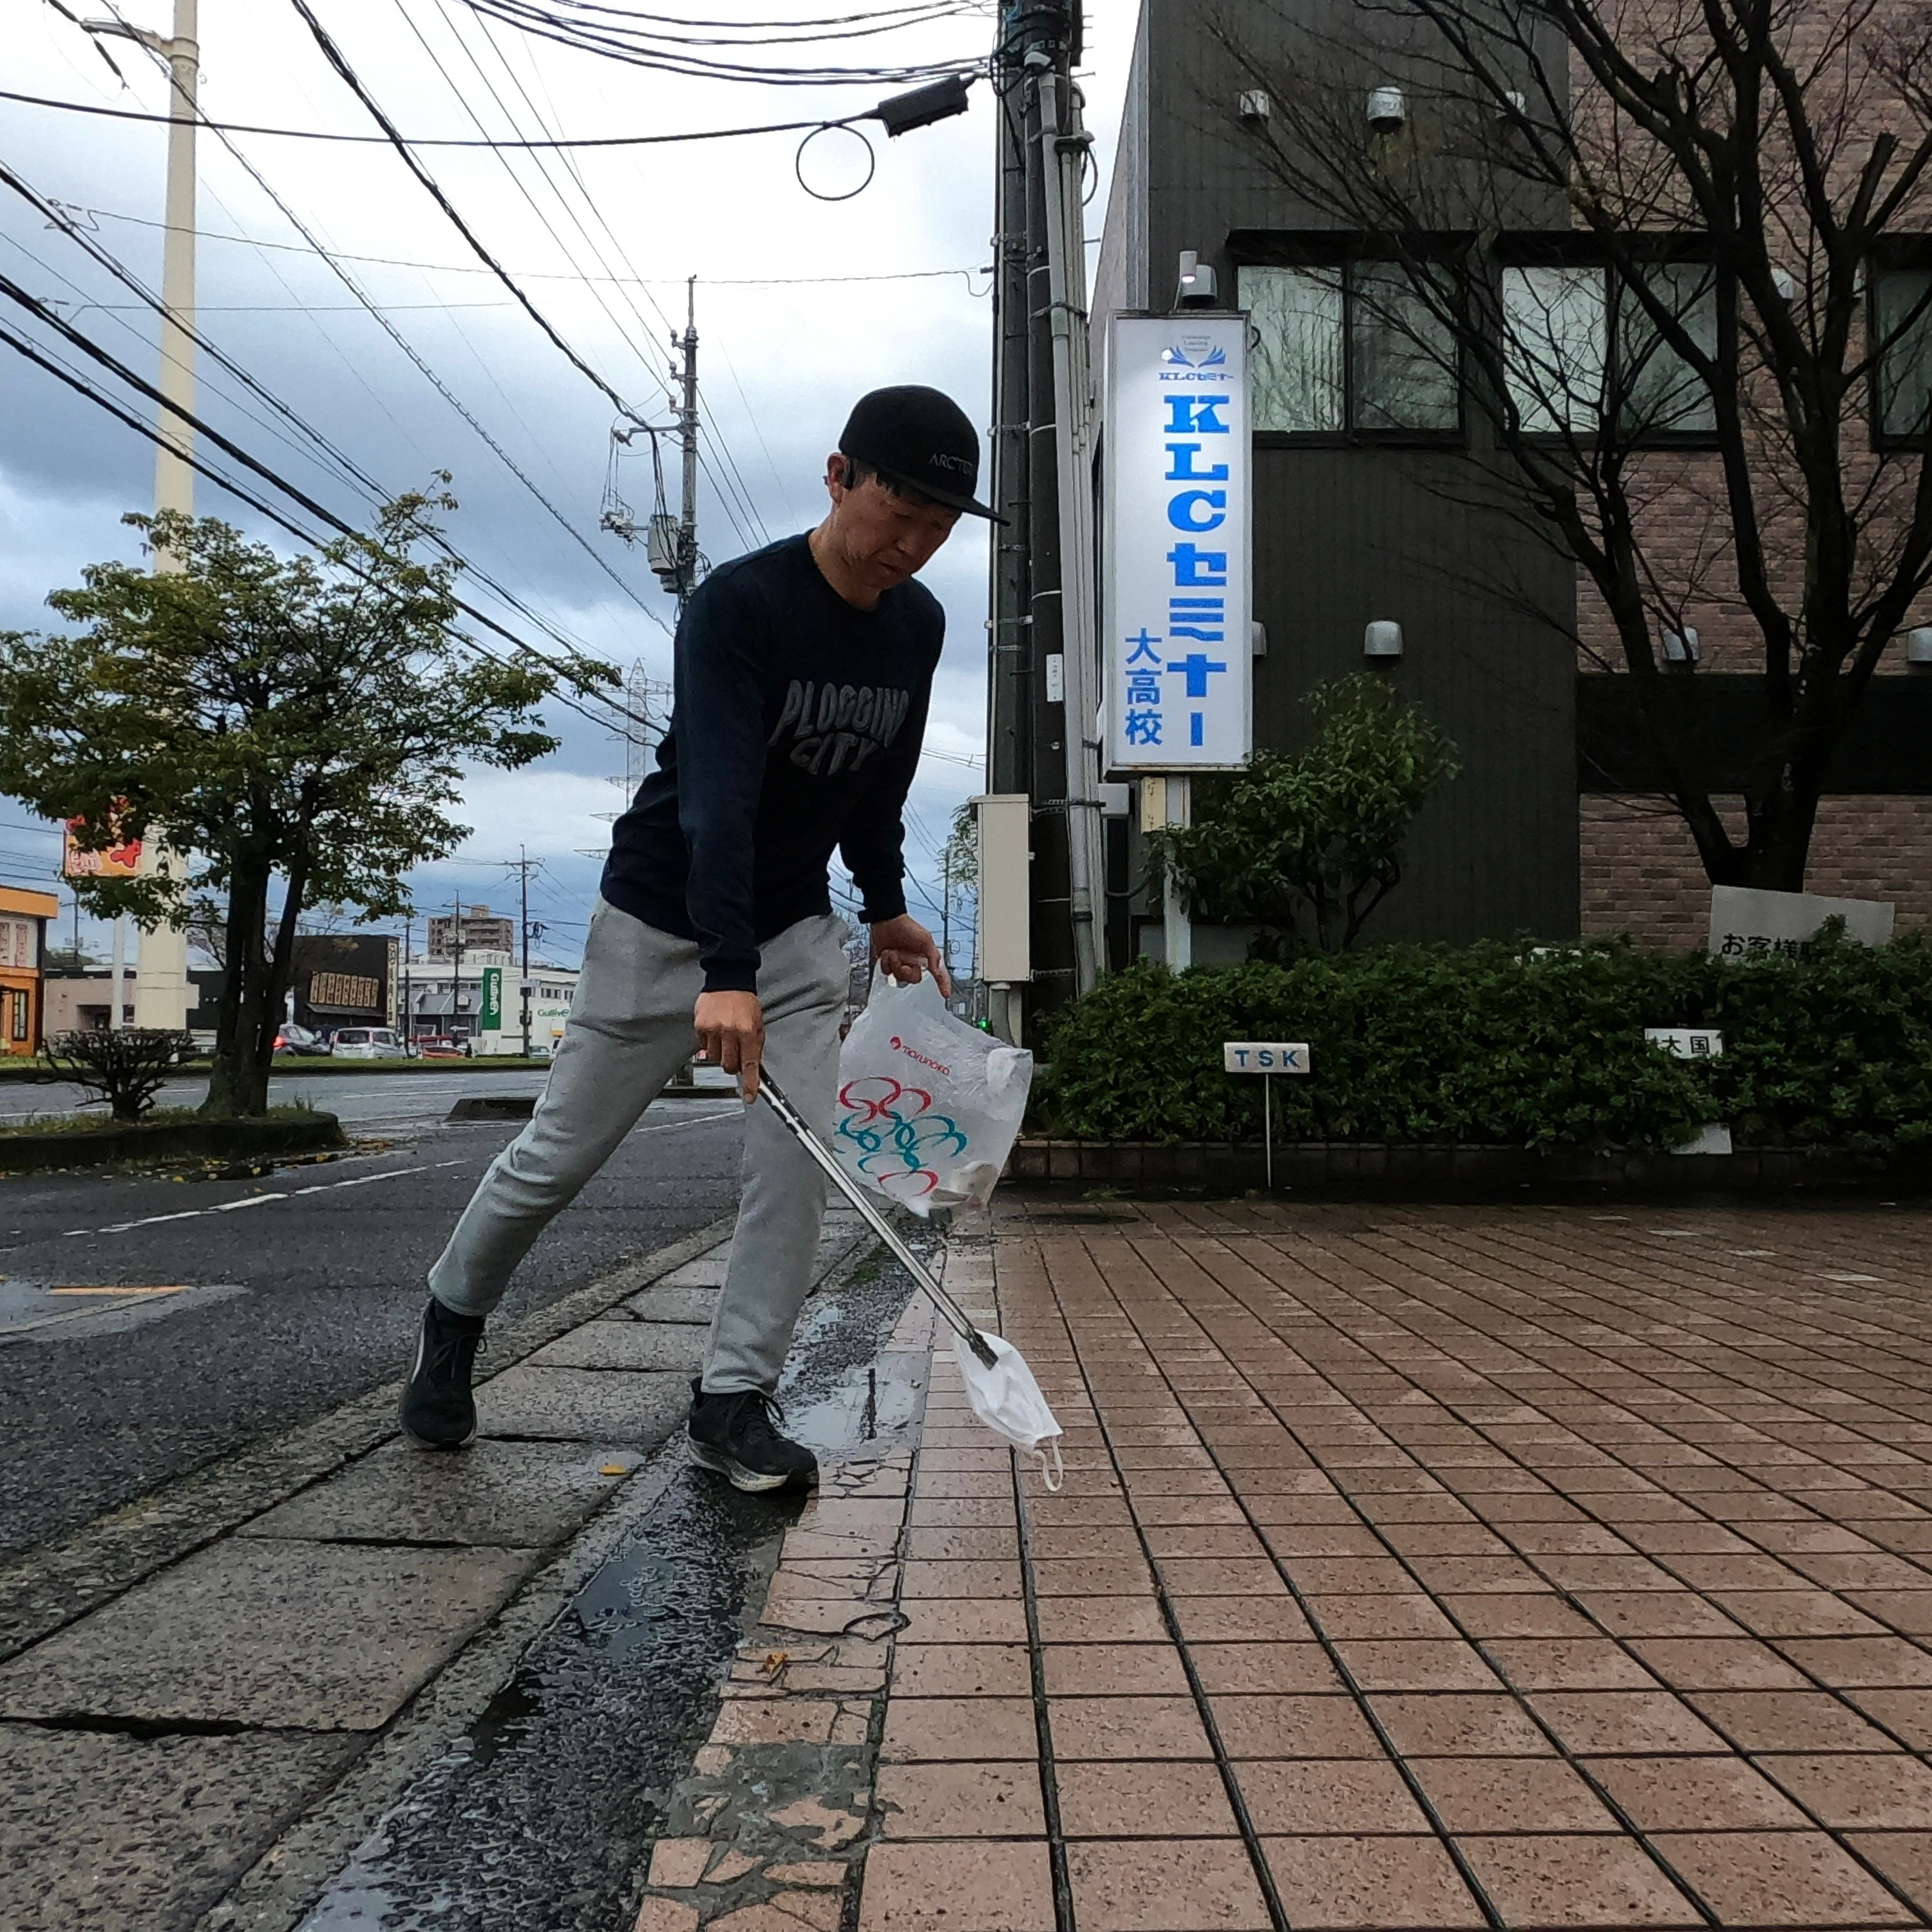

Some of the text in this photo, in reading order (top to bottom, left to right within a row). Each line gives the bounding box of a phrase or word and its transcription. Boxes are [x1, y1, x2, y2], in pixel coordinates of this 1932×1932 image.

[1163, 394, 1230, 746] KLCセミナー
[1125, 627, 1163, 746] 大高校
[790, 732, 880, 777] CITY
[1235, 1049, 1301, 1068] TSK
[1661, 1035, 1710, 1054] 大国
